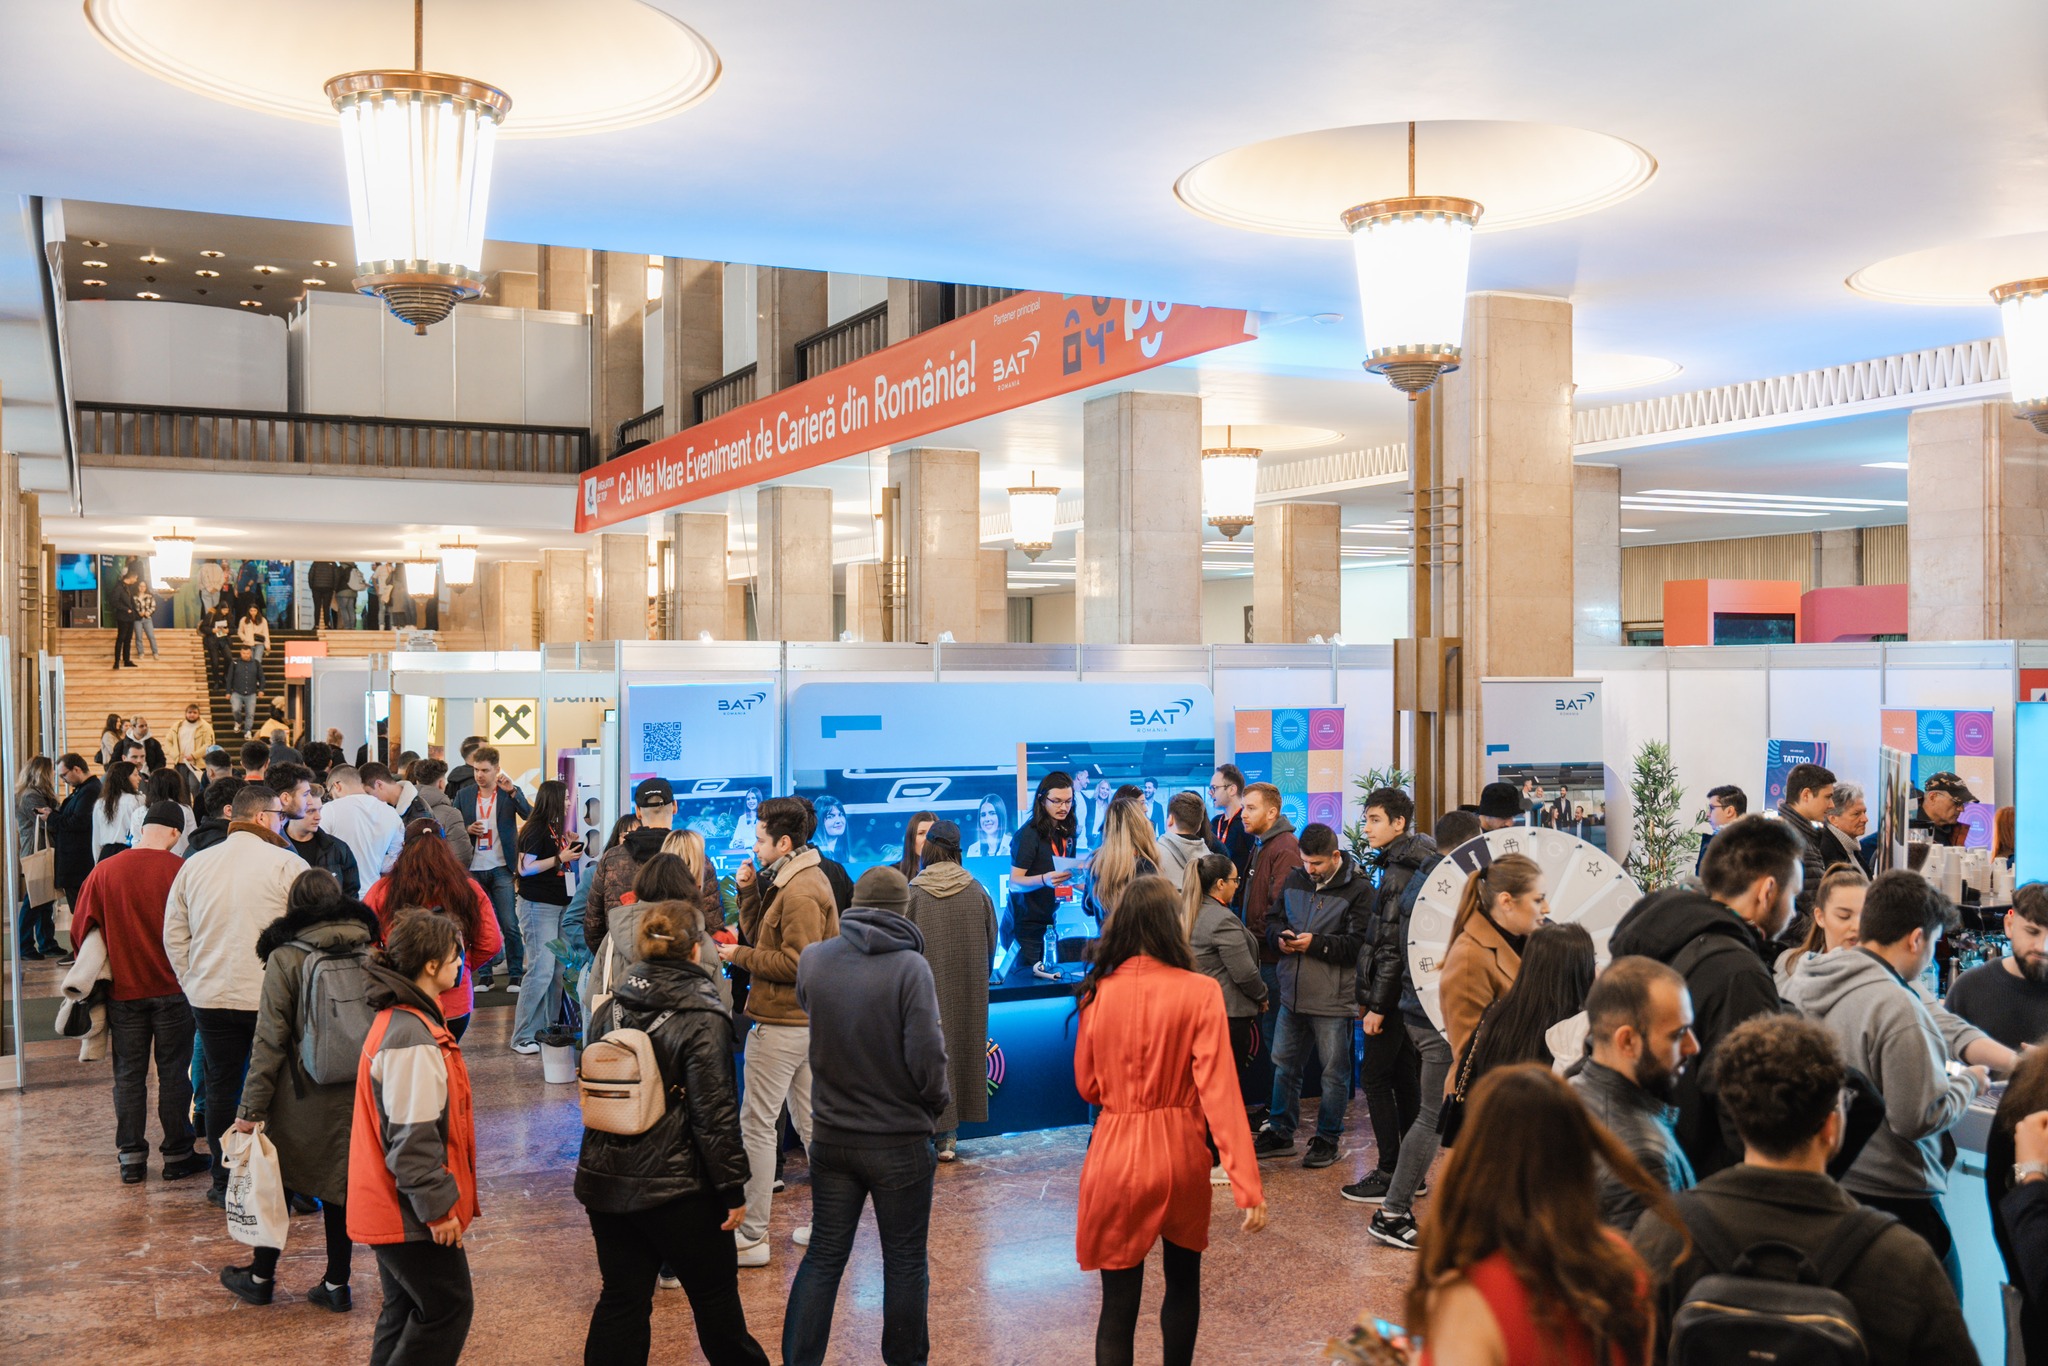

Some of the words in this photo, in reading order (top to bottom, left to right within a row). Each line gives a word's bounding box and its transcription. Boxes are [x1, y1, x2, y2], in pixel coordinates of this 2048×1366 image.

[994, 309, 1016, 327] Partener
[1016, 297, 1041, 323] principal
[993, 349, 1030, 383] BAT
[997, 380, 1020, 391] ROMANIA
[618, 467, 635, 505] Cel
[636, 463, 655, 500] Mai
[656, 456, 684, 494] Mare
[686, 429, 752, 483] Eveniment
[755, 417, 773, 462] de
[776, 394, 836, 454] Carieră
[840, 384, 868, 434] din
[874, 339, 976, 424] România!
[718, 700, 756, 710] BAT
[1555, 699, 1586, 710] BAT
[1130, 709, 1180, 725] BAT
[1783, 755, 1810, 764] TATTOO
